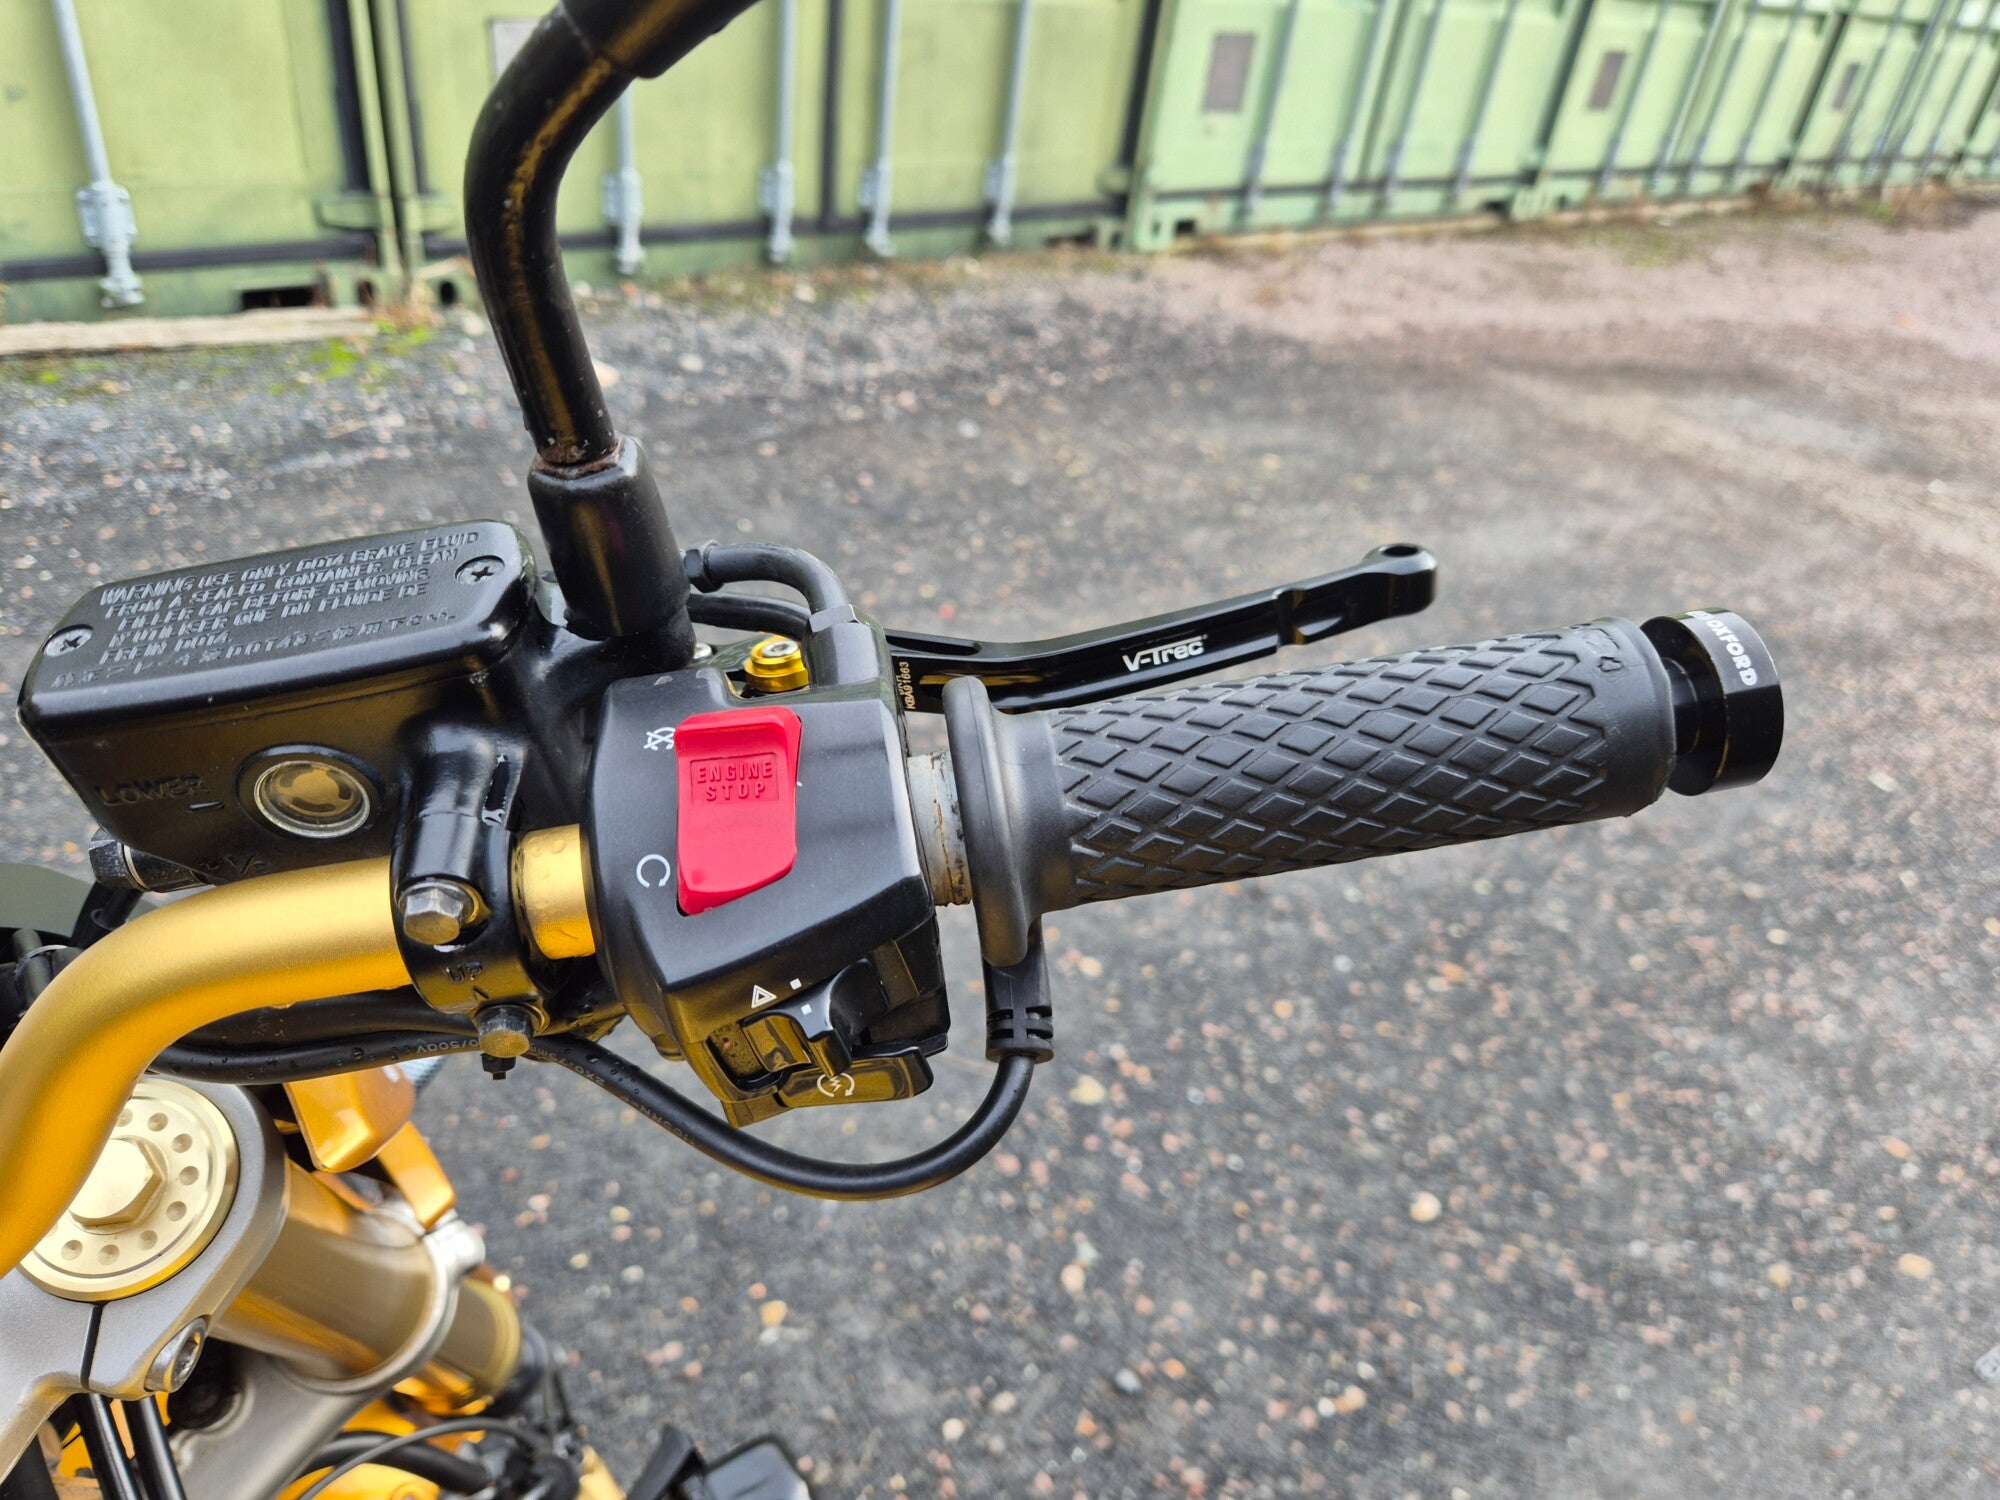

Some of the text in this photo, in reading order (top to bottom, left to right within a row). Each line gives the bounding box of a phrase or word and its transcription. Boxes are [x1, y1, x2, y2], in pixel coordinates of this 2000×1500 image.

[197, 571, 237, 589] USE
[240, 561, 292, 582] ONLY
[296, 554, 346, 573] DOT4
[349, 542, 415, 564] BRAKE
[420, 531, 479, 552] FLUID
[105, 597, 164, 619] FROM
[168, 594, 183, 609] A
[189, 581, 266, 605] SEALED
[392, 548, 459, 570] CLEAN
[117, 606, 194, 631] FILLER
[198, 599, 239, 617] CAP
[242, 585, 323, 611] BEFORE
[233, 607, 275, 627] QUE
[281, 602, 312, 618] DU
[318, 588, 393, 613] FLUIDE
[398, 582, 429, 599] DE
[99, 640, 168, 665] FREIN
[1121, 634, 1205, 672] V-Trec
[1705, 618, 1758, 687] OXFORD
[94, 773, 209, 808] LOWER
[696, 760, 773, 784] ENGINE
[705, 781, 766, 801] STOP
[443, 960, 484, 983] UP
